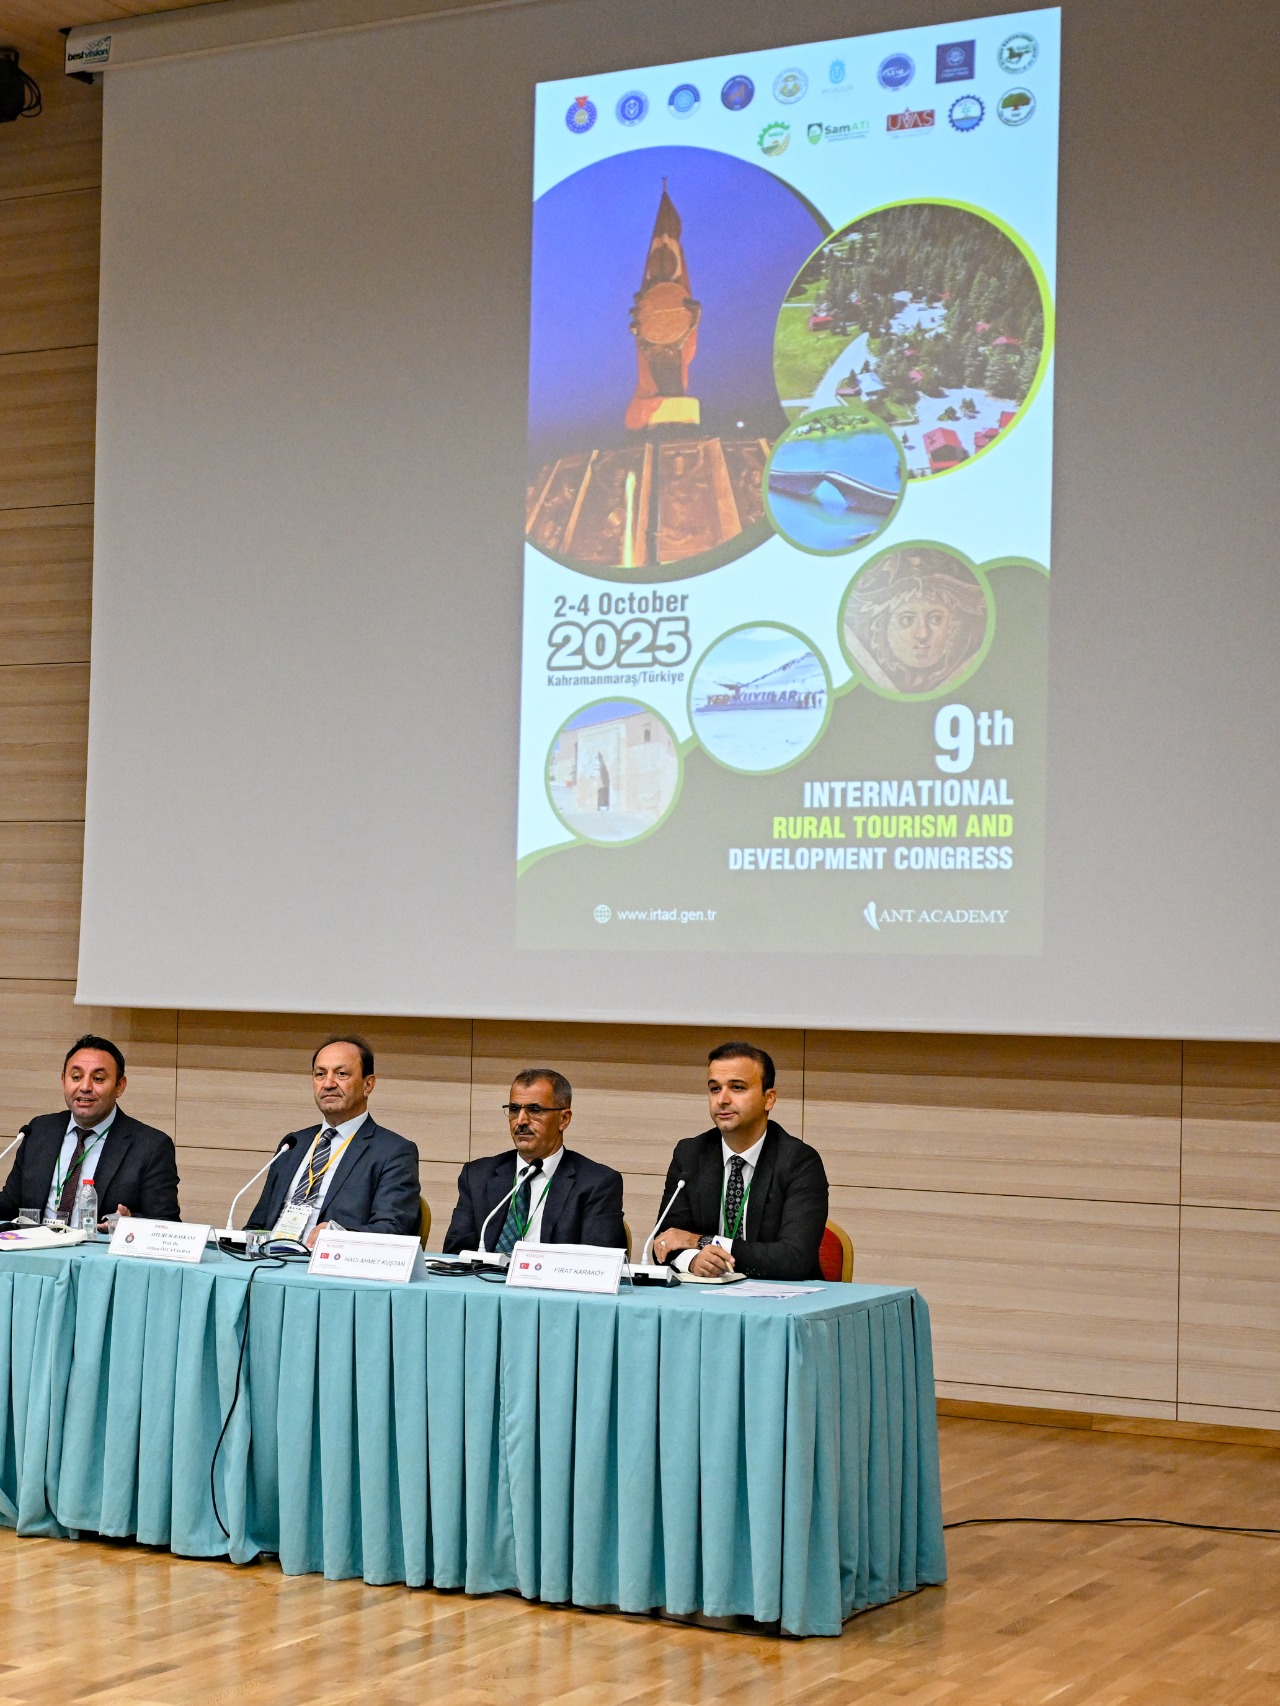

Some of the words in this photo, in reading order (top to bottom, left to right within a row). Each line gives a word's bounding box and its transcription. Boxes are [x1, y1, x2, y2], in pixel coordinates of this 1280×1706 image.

[824, 119, 870, 136] SamATI
[887, 109, 934, 130] UVAS
[554, 594, 590, 618] 2-4
[598, 590, 689, 615] October
[547, 616, 692, 671] 2025
[547, 671, 684, 687] Kahramanmaraş/Türkiye
[934, 703, 1014, 774] 9th
[803, 778, 1014, 808] INTERNATIONAL
[773, 816, 846, 840] RURAL
[853, 814, 958, 839] TOURISM
[965, 813, 1013, 838] AND
[728, 847, 887, 871] DEVELOPMENT
[894, 846, 1013, 870] CONGRESS
[617, 907, 718, 924] www.irtad.gen.tr
[878, 909, 915, 923] ANT
[918, 909, 1009, 924] ACADEMY
